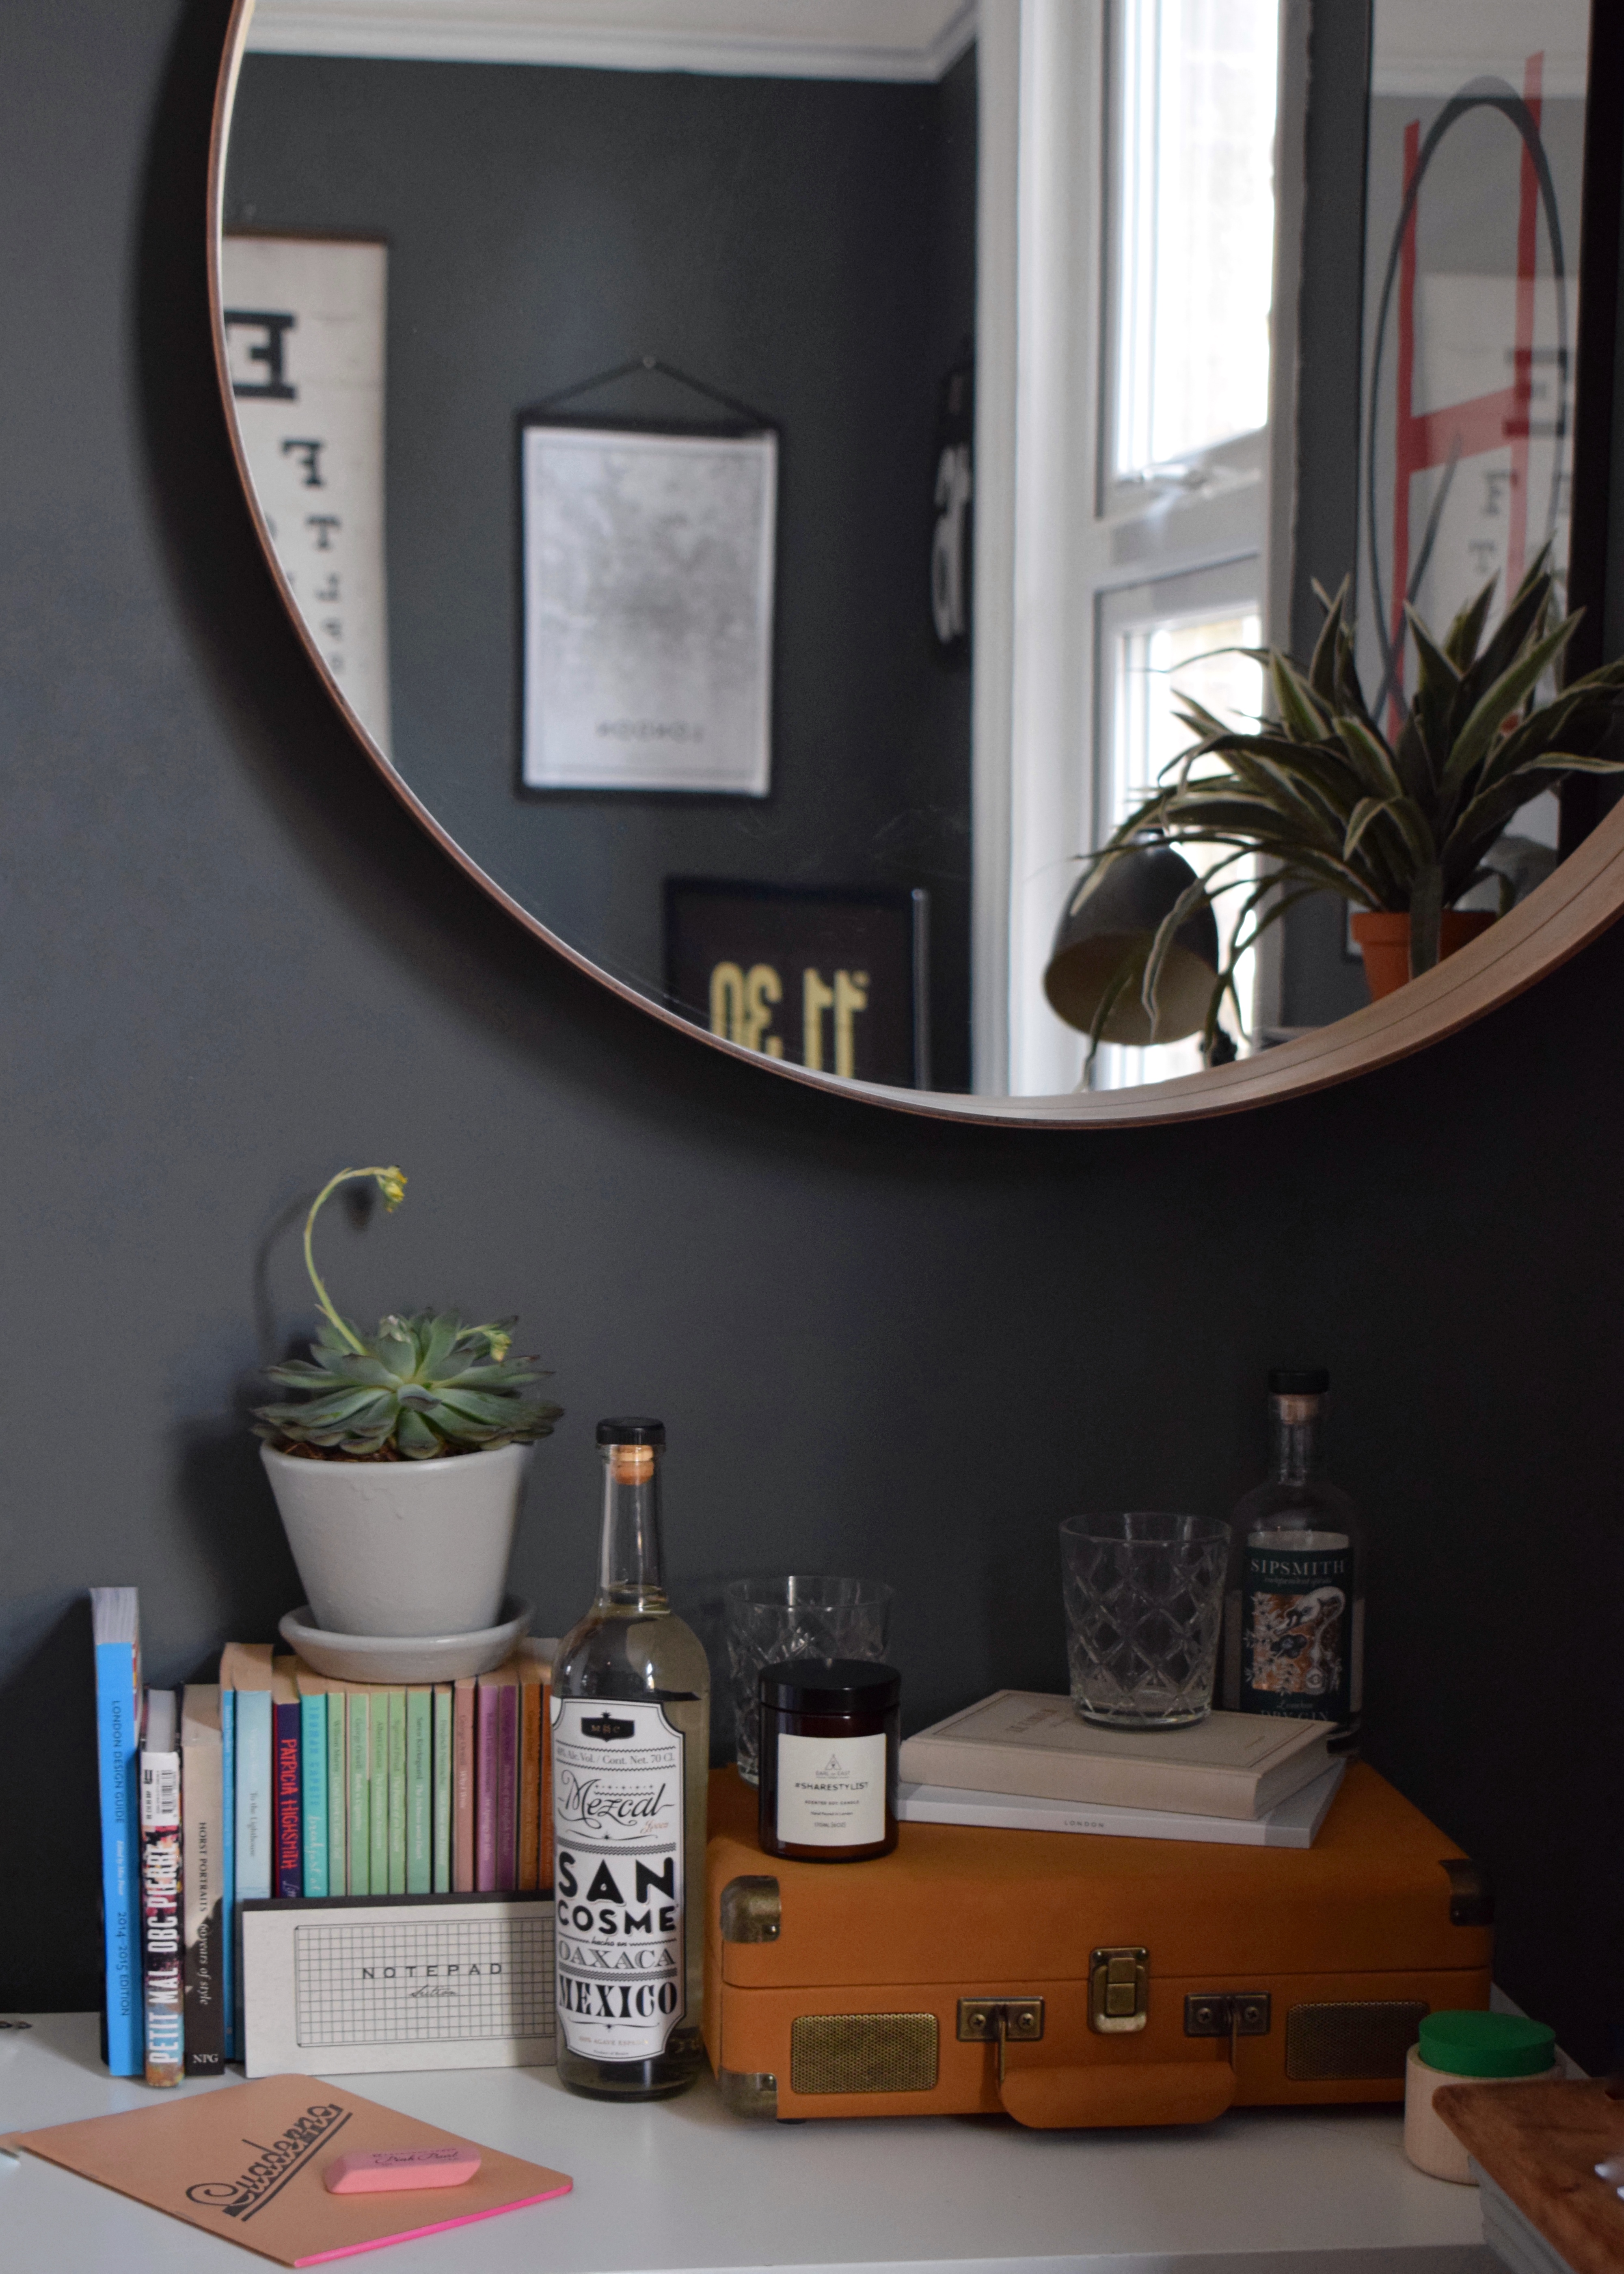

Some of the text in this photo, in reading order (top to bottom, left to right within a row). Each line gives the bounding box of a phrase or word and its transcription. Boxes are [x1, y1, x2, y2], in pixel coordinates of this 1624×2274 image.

[1250, 1559, 1345, 1575] SIPSMITH
[112, 1700, 125, 1823] LONDON DESIGN GUIDE
[280, 1738, 298, 1796] PATRICIA
[603, 1755, 627, 1764] Cont.
[630, 1755, 648, 1764] Net.
[650, 1754, 661, 1763] 70
[557, 1769, 675, 1829] Mezcal
[795, 1781, 869, 1791] #SHARESTYLIST
[250, 1803, 258, 1814] the
[1063, 1820, 1105, 1829] LONDON
[246, 1816, 258, 1857] Lighthouse
[281, 1800, 300, 1870] HIGHSMITH
[145, 1841, 178, 1909] PIERRE
[199, 1822, 208, 1912] HORST PORTRAITS
[558, 1851, 674, 1905] SAN
[147, 1916, 178, 1953] DBC
[558, 1899, 676, 1935] COSME
[362, 1963, 502, 1980] NOTEPAD
[559, 1940, 677, 1969] OAXACA
[120, 1974, 130, 2016] EDITION
[148, 1966, 178, 2004] MAL
[197, 1981, 211, 2005] style
[559, 1974, 677, 2018] MEXICO
[149, 2011, 179, 2064] PETIT
[192, 2053, 219, 2064] NPG
